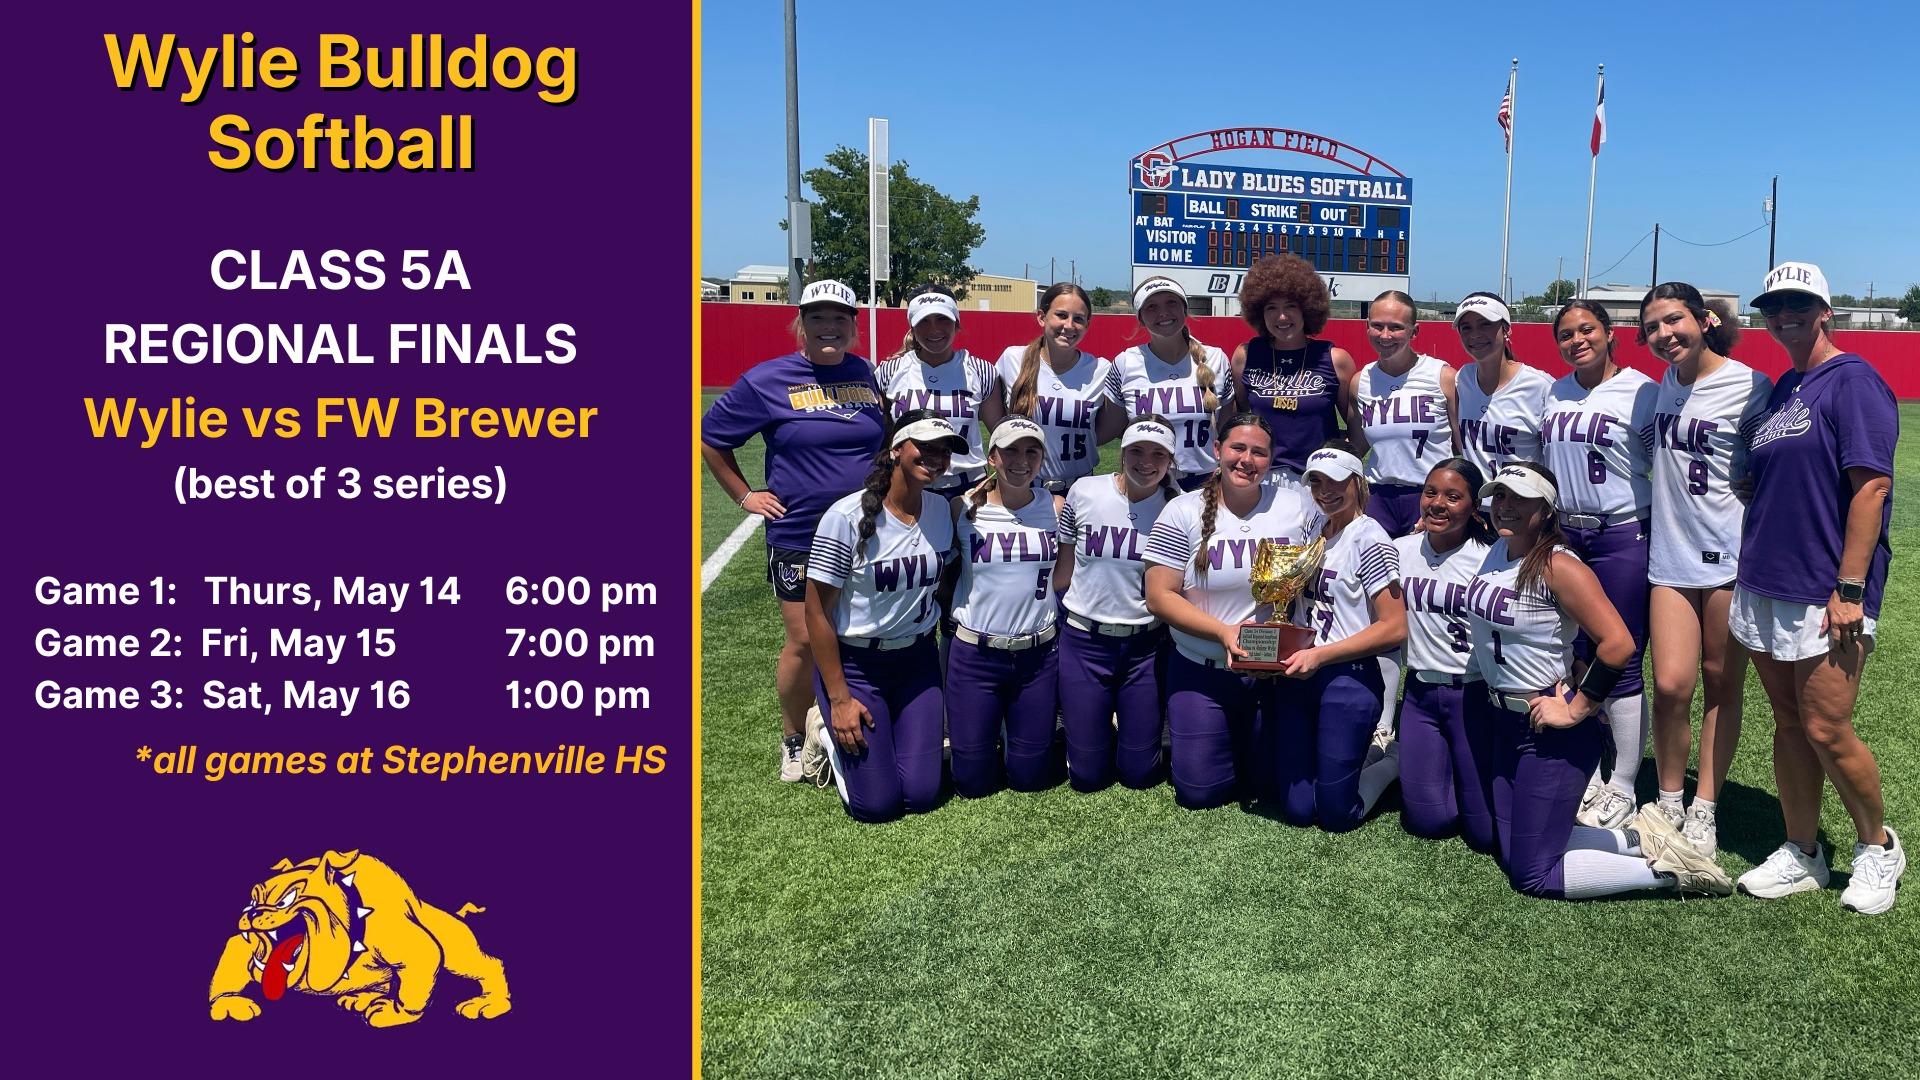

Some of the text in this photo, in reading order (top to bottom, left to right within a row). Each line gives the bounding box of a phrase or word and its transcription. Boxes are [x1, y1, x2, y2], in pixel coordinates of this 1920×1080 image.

[1211, 130, 1338, 159] HOGAN FIELD
[1181, 168, 1408, 200] LADY BLUES SOFTBALL
[1135, 215, 1175, 227] AT BAT
[1189, 200, 1225, 215] BALL
[1250, 203, 1298, 219] STRIKE
[1320, 207, 1348, 221] OUT
[1146, 229, 1197, 245] VISITOR
[1210, 221, 1404, 239] 1 2 3 4 5 6 7 8 9 10 R H E
[1148, 248, 1193, 262] HOME
[810, 283, 850, 303] WYLIE
[1145, 281, 1170, 292] Wylie
[1766, 266, 1812, 292] WYLIE
[918, 296, 946, 305] Wylie
[1462, 299, 1487, 309] Wylie
[895, 388, 974, 419] WYLIE
[1038, 395, 1095, 430] YLIE
[1273, 396, 1298, 411] DISCO
[1362, 395, 1436, 429] WYLIE
[1010, 420, 1038, 432] Wylie
[1136, 424, 1164, 434] Wylie
[1183, 419, 1211, 448] 16
[1543, 411, 1620, 448] WYLIE
[1060, 433, 1087, 461] 15
[1311, 451, 1338, 461] Wylie
[1412, 429, 1430, 460] 7
[1498, 468, 1526, 478] Wylie
[1587, 450, 1607, 485] 6
[1688, 459, 1709, 496] 9
[969, 530, 1057, 563] WYLIE
[1085, 524, 1142, 561] WYL
[874, 550, 945, 592] WYLI
[1034, 567, 1053, 600] 5
[1468, 575, 1519, 627] YLIE
[1447, 621, 1470, 653] 3
[1491, 629, 1507, 665] 1
